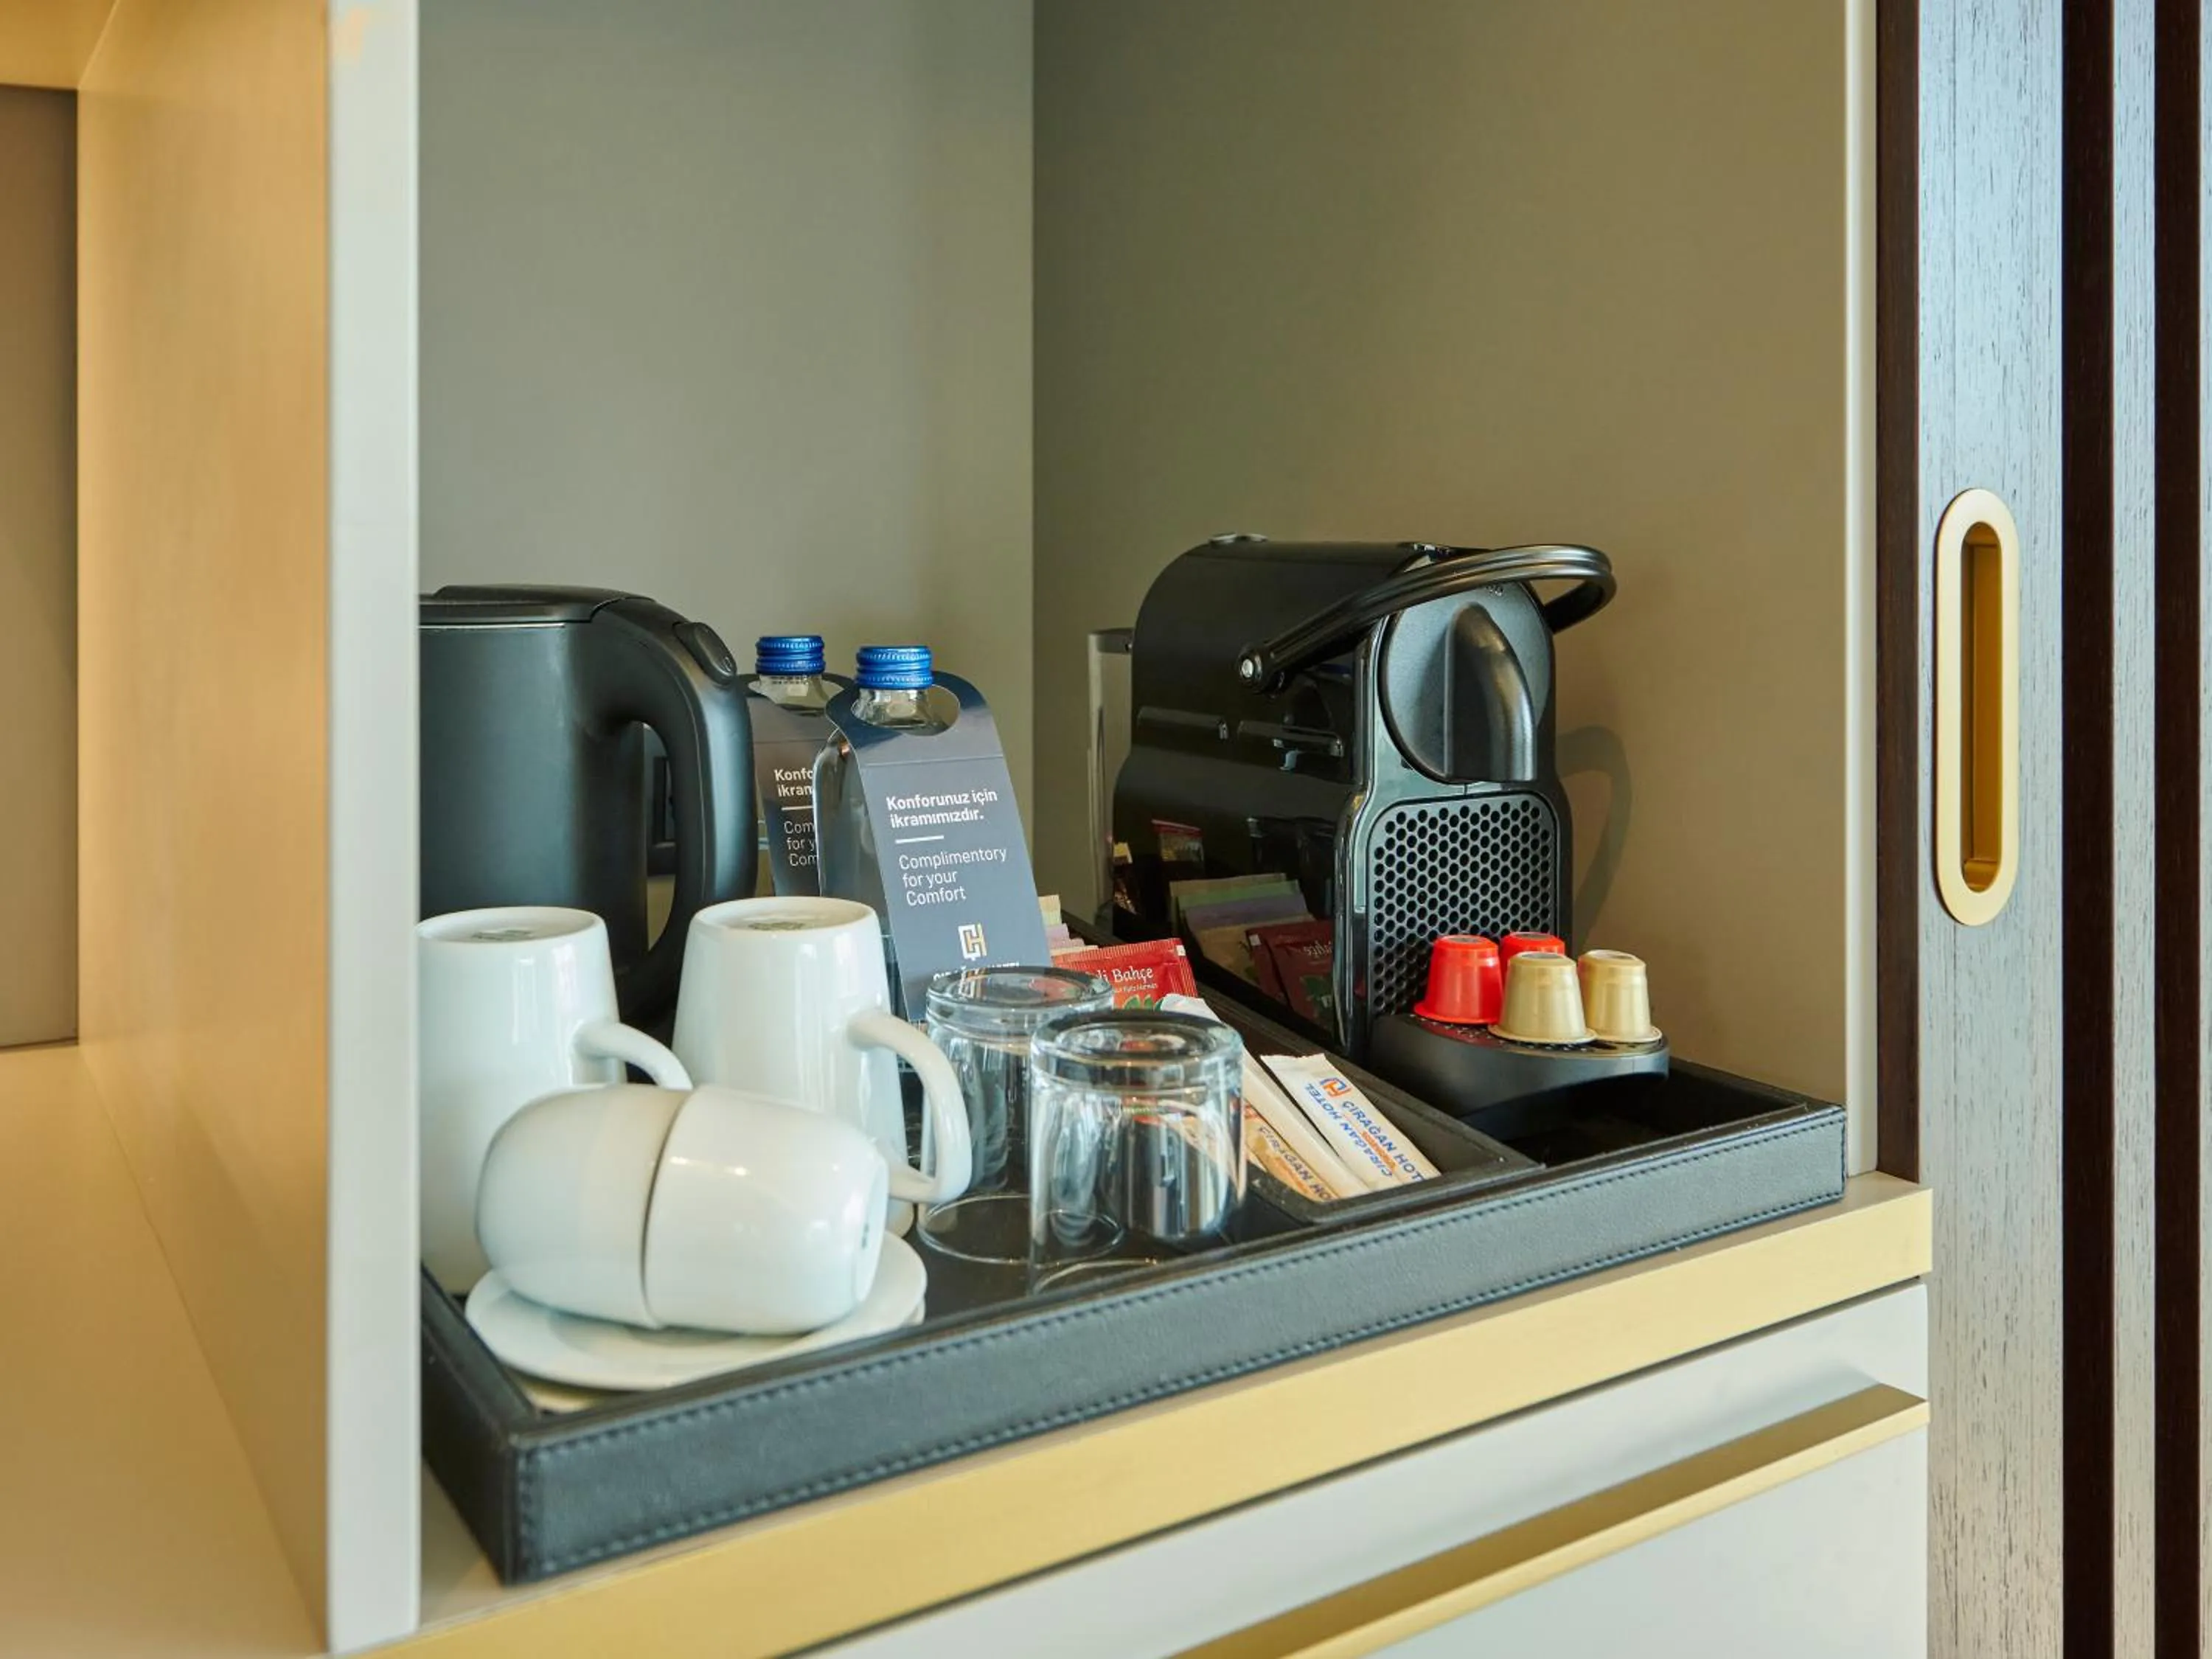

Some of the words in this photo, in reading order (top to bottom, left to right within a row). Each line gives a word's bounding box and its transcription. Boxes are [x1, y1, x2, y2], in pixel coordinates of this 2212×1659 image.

[886, 793, 970, 811] Konforunuz
[971, 788, 998, 805] için
[899, 848, 1007, 870] Complimentory
[902, 872, 925, 888] for
[925, 870, 958, 888] your
[906, 886, 967, 906] Comfort
[1112, 965, 1154, 984] Bahçe
